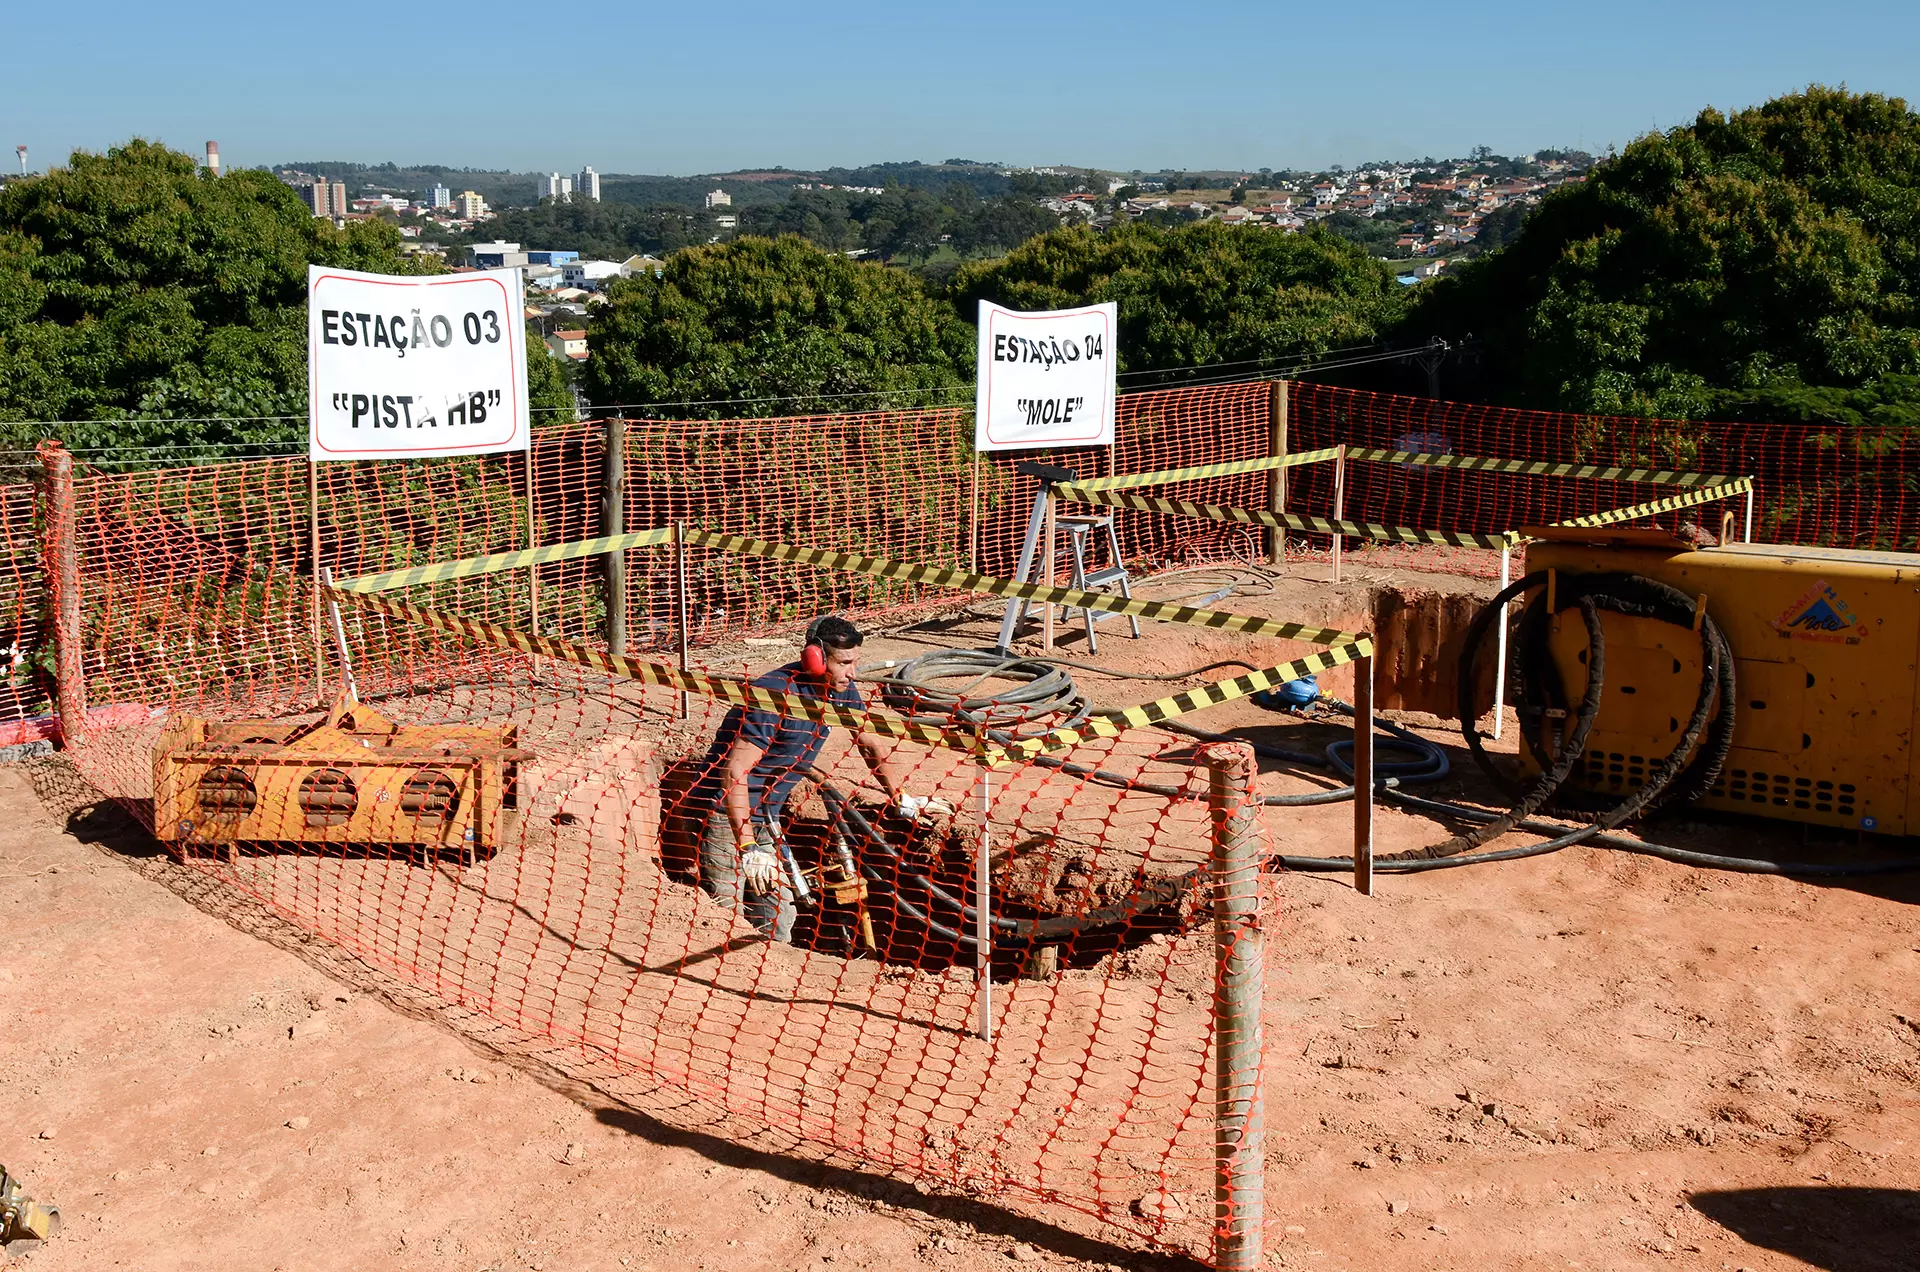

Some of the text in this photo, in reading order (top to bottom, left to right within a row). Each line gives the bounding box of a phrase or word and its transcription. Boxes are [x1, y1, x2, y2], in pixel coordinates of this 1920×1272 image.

[322, 308, 501, 358] ESTAÇÃO 03
[994, 333, 1103, 372] ESTAÇÃO 04
